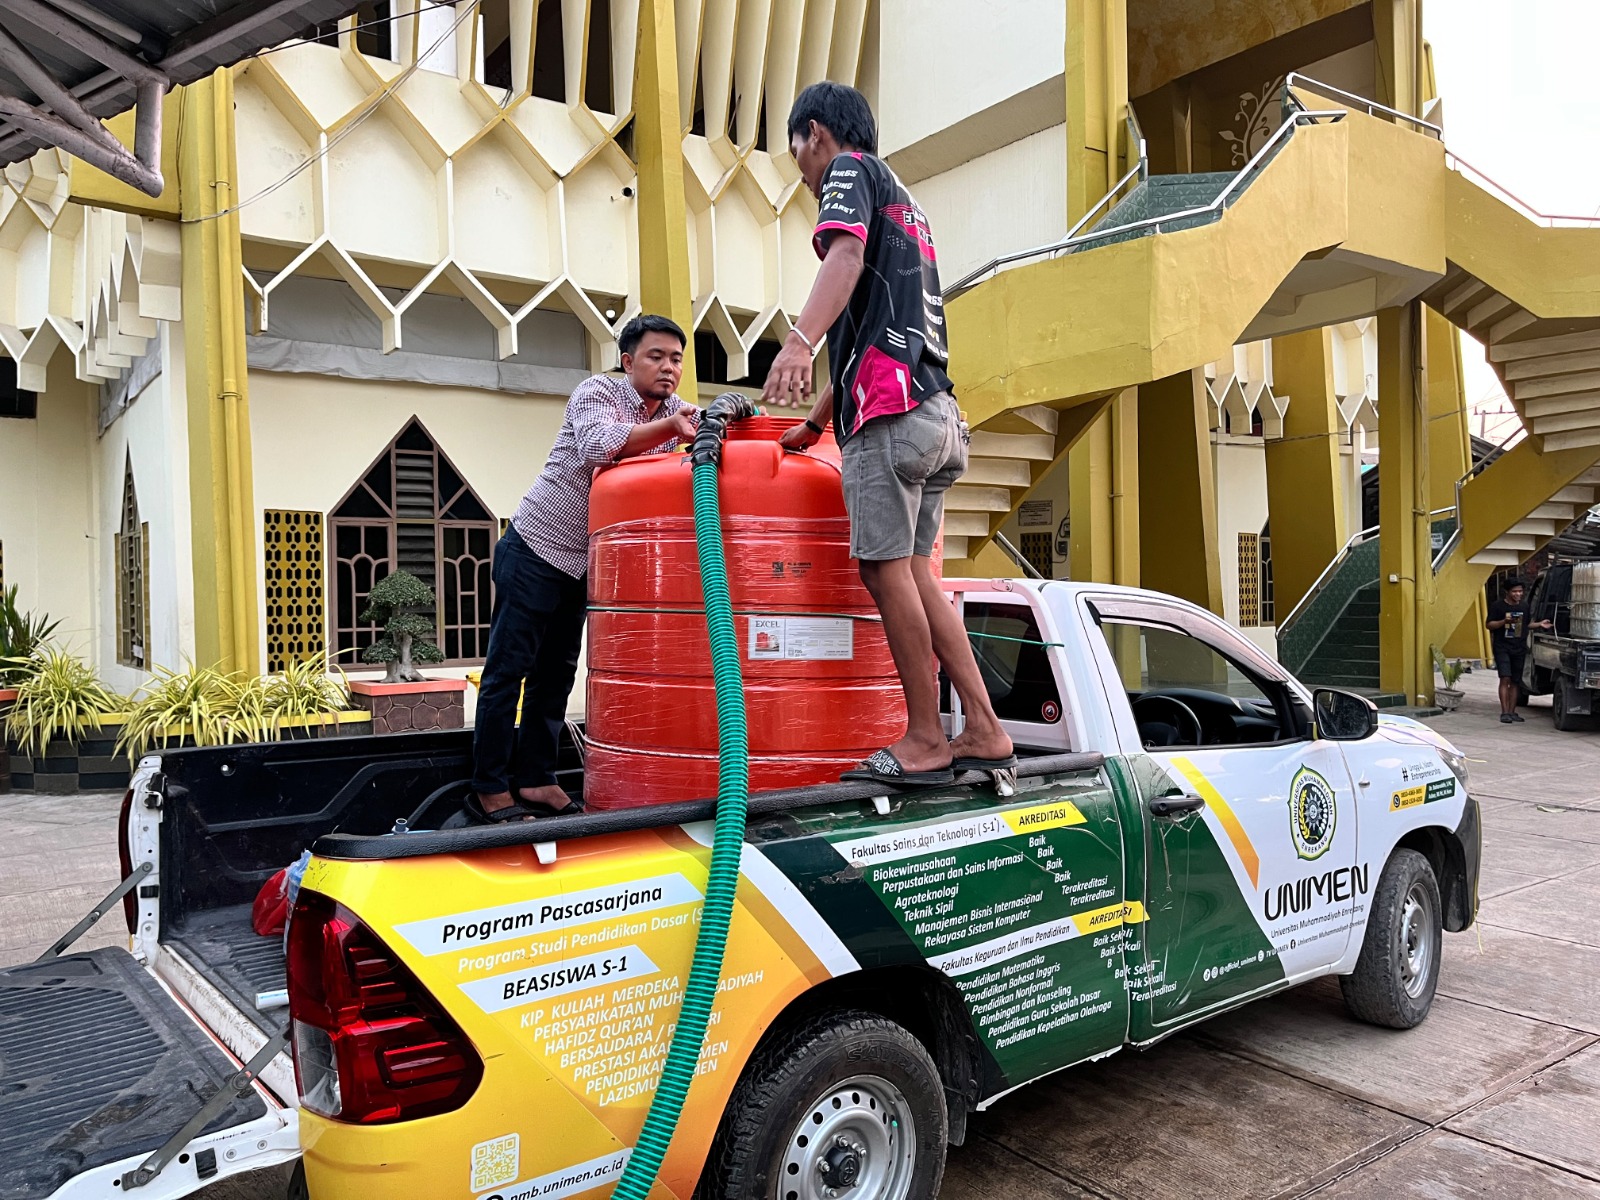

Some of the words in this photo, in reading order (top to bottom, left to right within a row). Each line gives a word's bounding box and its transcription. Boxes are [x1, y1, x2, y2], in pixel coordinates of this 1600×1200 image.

[755, 620, 780, 628] EXCEL
[851, 843, 891, 859] Fakultas
[893, 838, 916, 851] Sains
[918, 835, 935, 847] dan
[936, 825, 977, 842] Teknologi
[1018, 809, 1066, 826] AKREDITASI
[873, 856, 956, 882] Biokewirausahaan
[1029, 834, 1046, 848] Baik
[882, 872, 945, 894] Perpustakaan
[947, 868, 963, 880] dan
[965, 863, 985, 876] Sains
[987, 852, 1024, 870] Informasi
[1037, 845, 1054, 858] Baik
[894, 883, 959, 909] Agroteknologi
[1046, 858, 1063, 871] Baik
[1264, 863, 1368, 921] UNIMEN
[442, 913, 533, 943] Program
[540, 887, 662, 924] Pascasarjana
[904, 905, 933, 922] Teknik
[935, 900, 954, 916] Sipil
[1054, 870, 1072, 883] Baik
[915, 914, 968, 936] Manajemen
[970, 904, 993, 920] Bisnis
[994, 890, 1044, 913] Internasional
[1062, 875, 1108, 895] Terakreditasi
[924, 929, 966, 948] Rekayasa
[968, 920, 993, 937] Sistem
[995, 908, 1031, 929] Komputer
[1070, 886, 1116, 907] Terakreditasi
[458, 949, 526, 974] Program
[530, 936, 567, 957] Studi
[571, 921, 647, 948] Pendidikan
[651, 913, 689, 931] Dasar
[940, 955, 973, 972] Fakultas
[974, 945, 1006, 964] Keguruan
[1007, 940, 1019, 952] dan
[1020, 934, 1034, 949] Ilmu
[1035, 925, 1070, 944] Pendidikan
[1089, 907, 1132, 926] AKREDITASI
[1271, 924, 1299, 939] Universitas
[1300, 910, 1341, 929] Muhammadiyah
[503, 963, 597, 1000] BEASISWA
[602, 956, 628, 976] S-1
[956, 972, 1000, 991] Pendidikan
[1001, 954, 1045, 978] Matematika
[1093, 934, 1109, 947] Baik
[964, 983, 1007, 1002] Pendidikan
[1009, 974, 1034, 989] Bahasa
[1036, 962, 1061, 979] Inggris
[1100, 946, 1116, 958] Baik
[520, 1009, 544, 1029] KIP
[552, 994, 605, 1020] KULIAH
[612, 976, 679, 1004] MERDEKA
[971, 996, 1014, 1016] Pendidikan
[1015, 977, 1054, 1001] Nonformal
[979, 1005, 1020, 1027] Bimbingan
[1021, 998, 1035, 1011] dan
[1037, 985, 1072, 1004] Konseling
[988, 1015, 1030, 1038] Pendidikan
[1031, 1008, 1049, 1023] Guru
[1050, 996, 1079, 1015] Sekolah
[1080, 990, 1102, 1004] Dasar
[534, 1000, 645, 1043] PERSYARIKATAN
[545, 1028, 597, 1056] HAFIDZ
[995, 1027, 1036, 1050] Pendidikan
[1037, 1012, 1079, 1035] Kepelatihan
[1080, 1001, 1112, 1019] Olahraga
[560, 1030, 653, 1068] BERSAUDARA
[574, 1050, 636, 1082] PRESTASI
